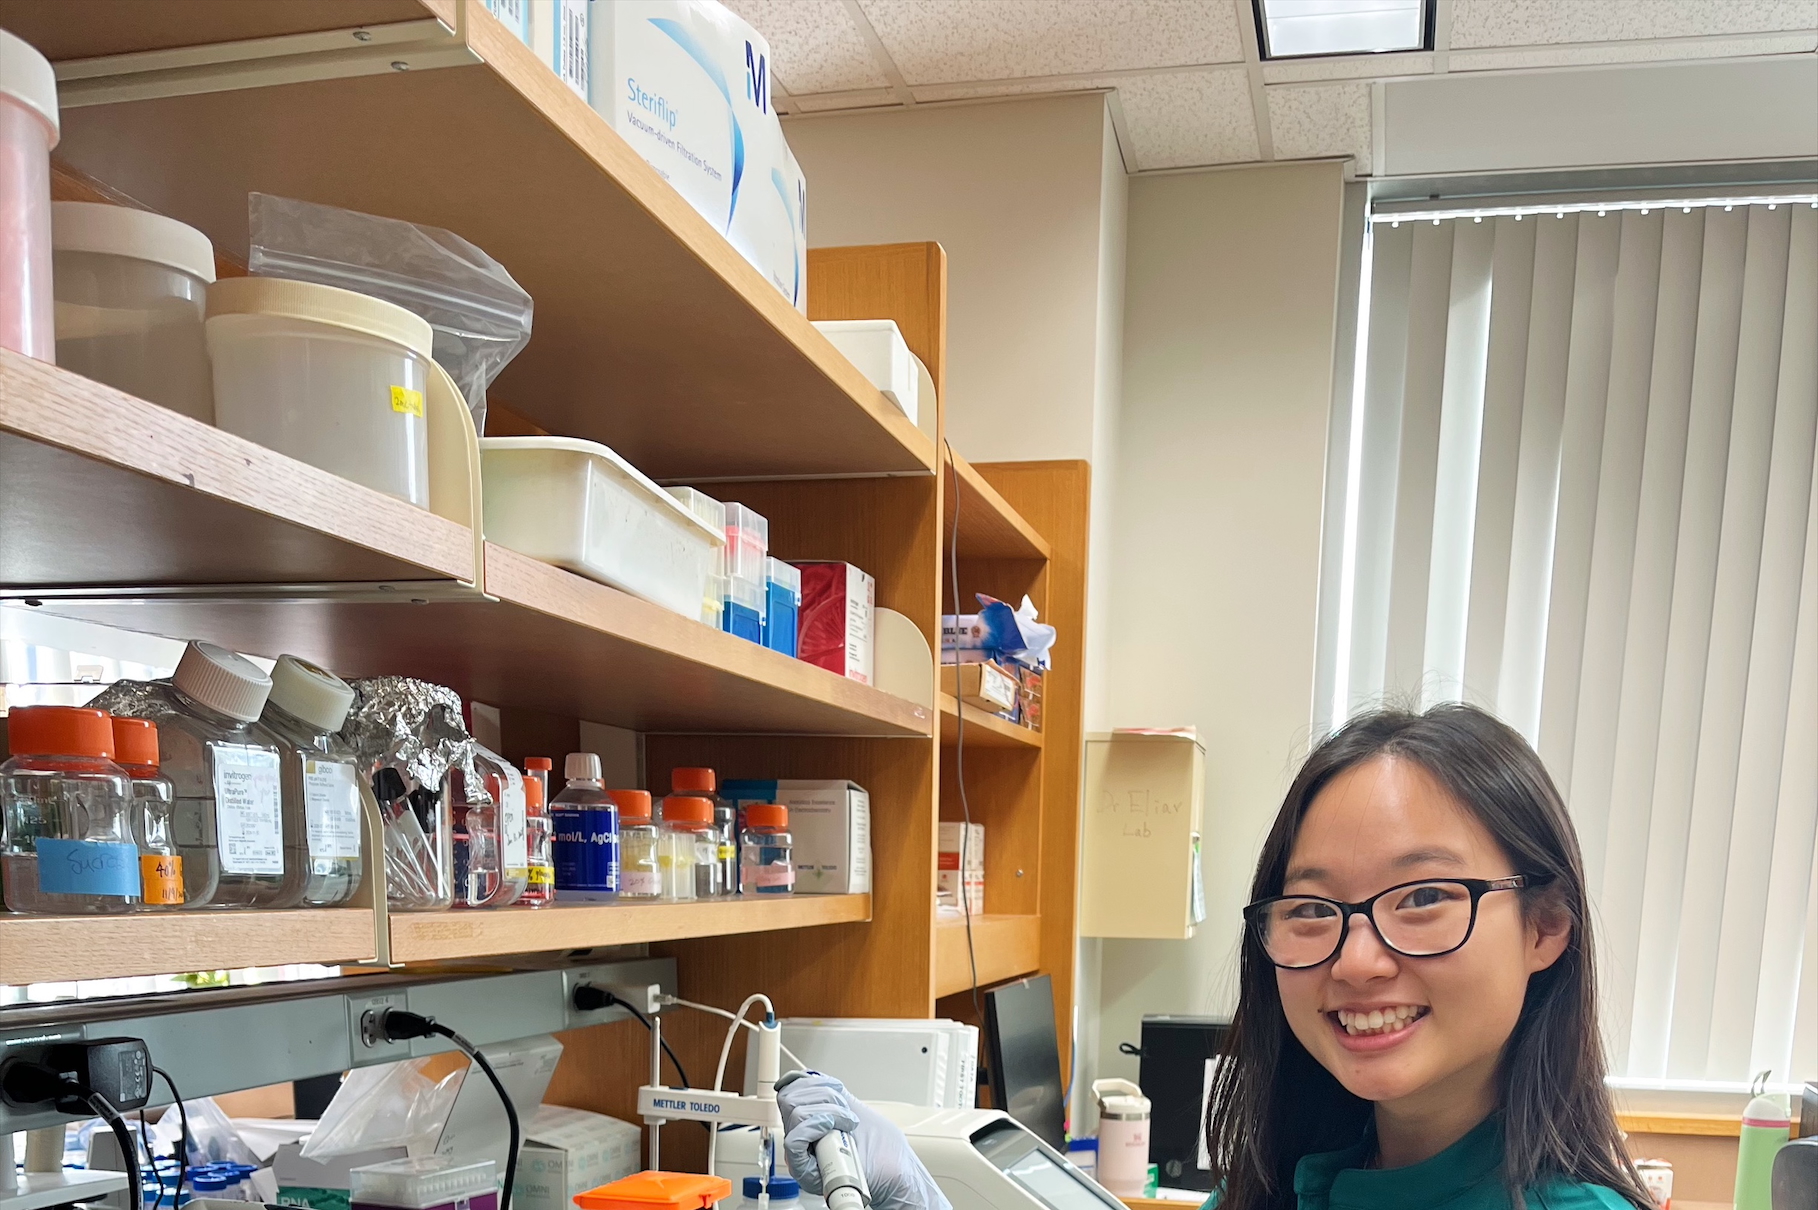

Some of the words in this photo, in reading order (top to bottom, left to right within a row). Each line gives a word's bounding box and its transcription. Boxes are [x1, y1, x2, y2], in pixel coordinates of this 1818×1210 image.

[627, 109, 676, 151] Vacuum-driven
[676, 140, 703, 168] Filtration
[702, 159, 723, 183] System
[1123, 821, 1152, 838] Lab
[653, 1098, 687, 1111] METTLER
[689, 1101, 720, 1114] TOLEDO
[525, 1184, 549, 1195] OMNI
